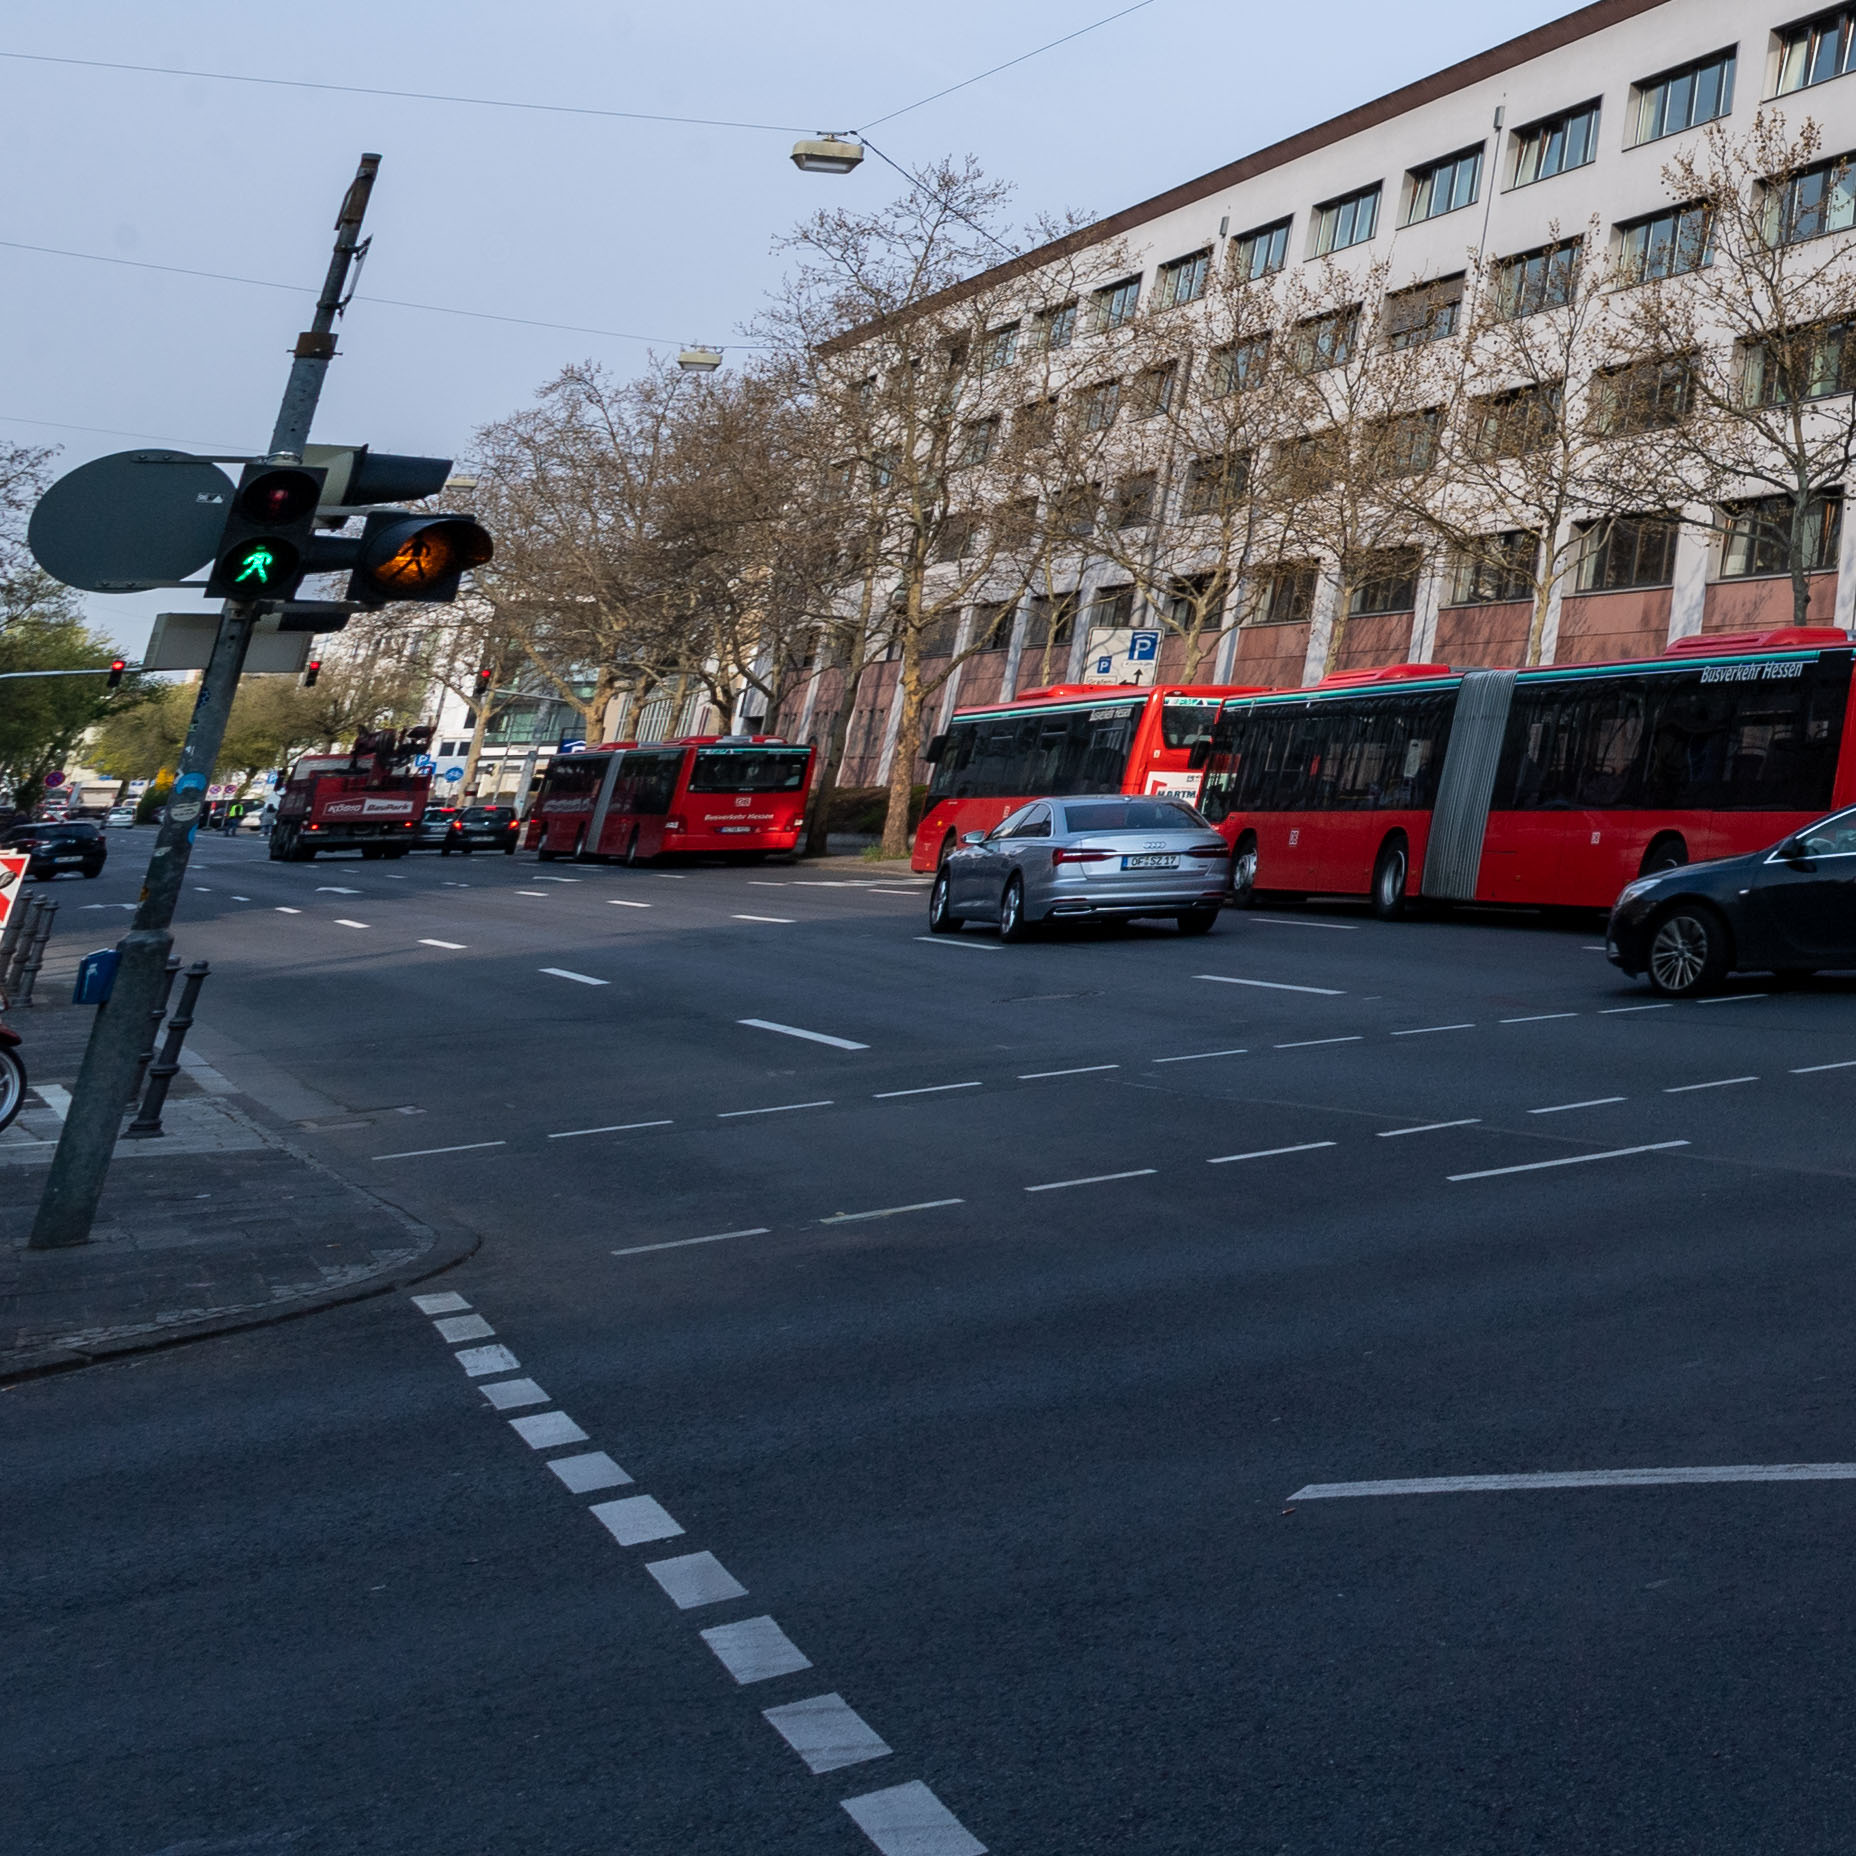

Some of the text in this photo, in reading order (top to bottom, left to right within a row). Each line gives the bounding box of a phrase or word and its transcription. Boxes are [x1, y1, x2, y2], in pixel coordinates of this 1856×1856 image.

[1700, 660, 1804, 684] Busverkehr Hessen
[1130, 855, 1177, 866] OF SZ 17
